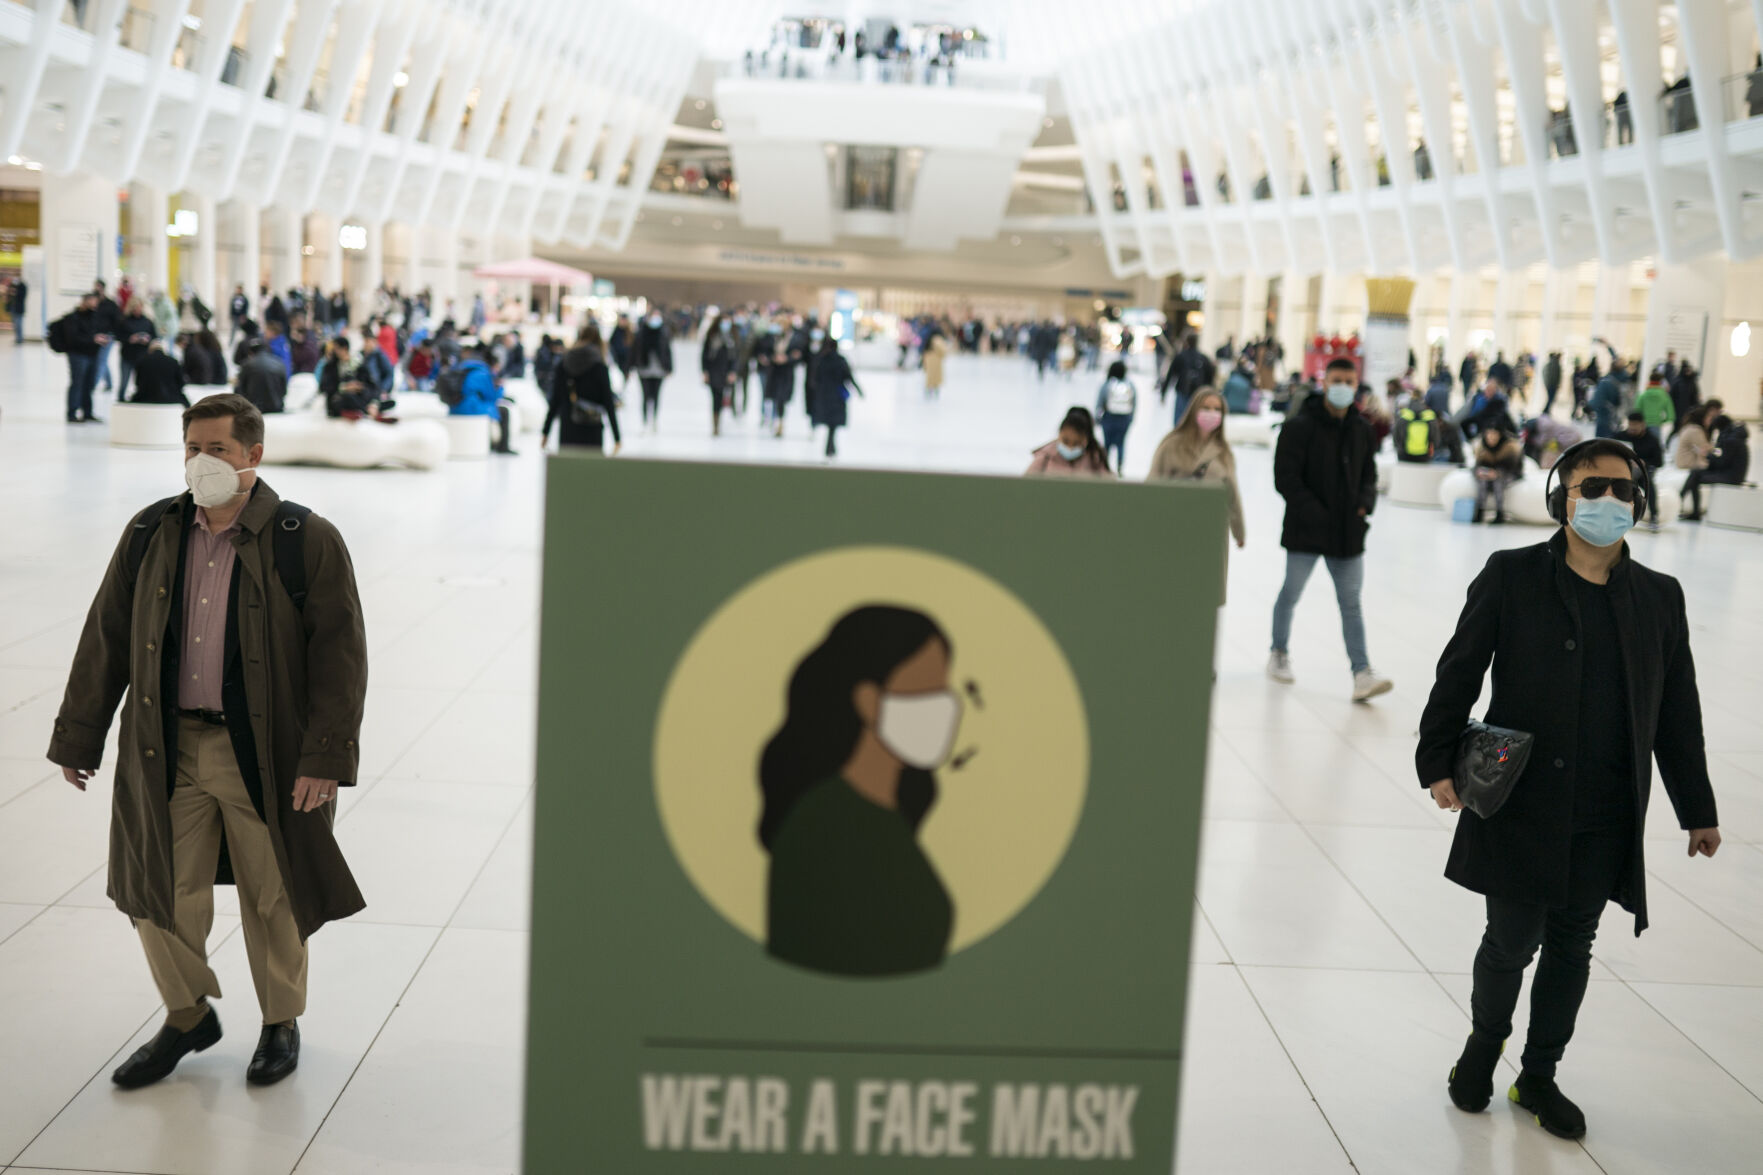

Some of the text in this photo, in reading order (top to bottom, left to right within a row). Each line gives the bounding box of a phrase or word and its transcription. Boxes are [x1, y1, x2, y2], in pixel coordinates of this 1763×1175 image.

[641, 1074, 1138, 1159] WEAR A FACE MASK
